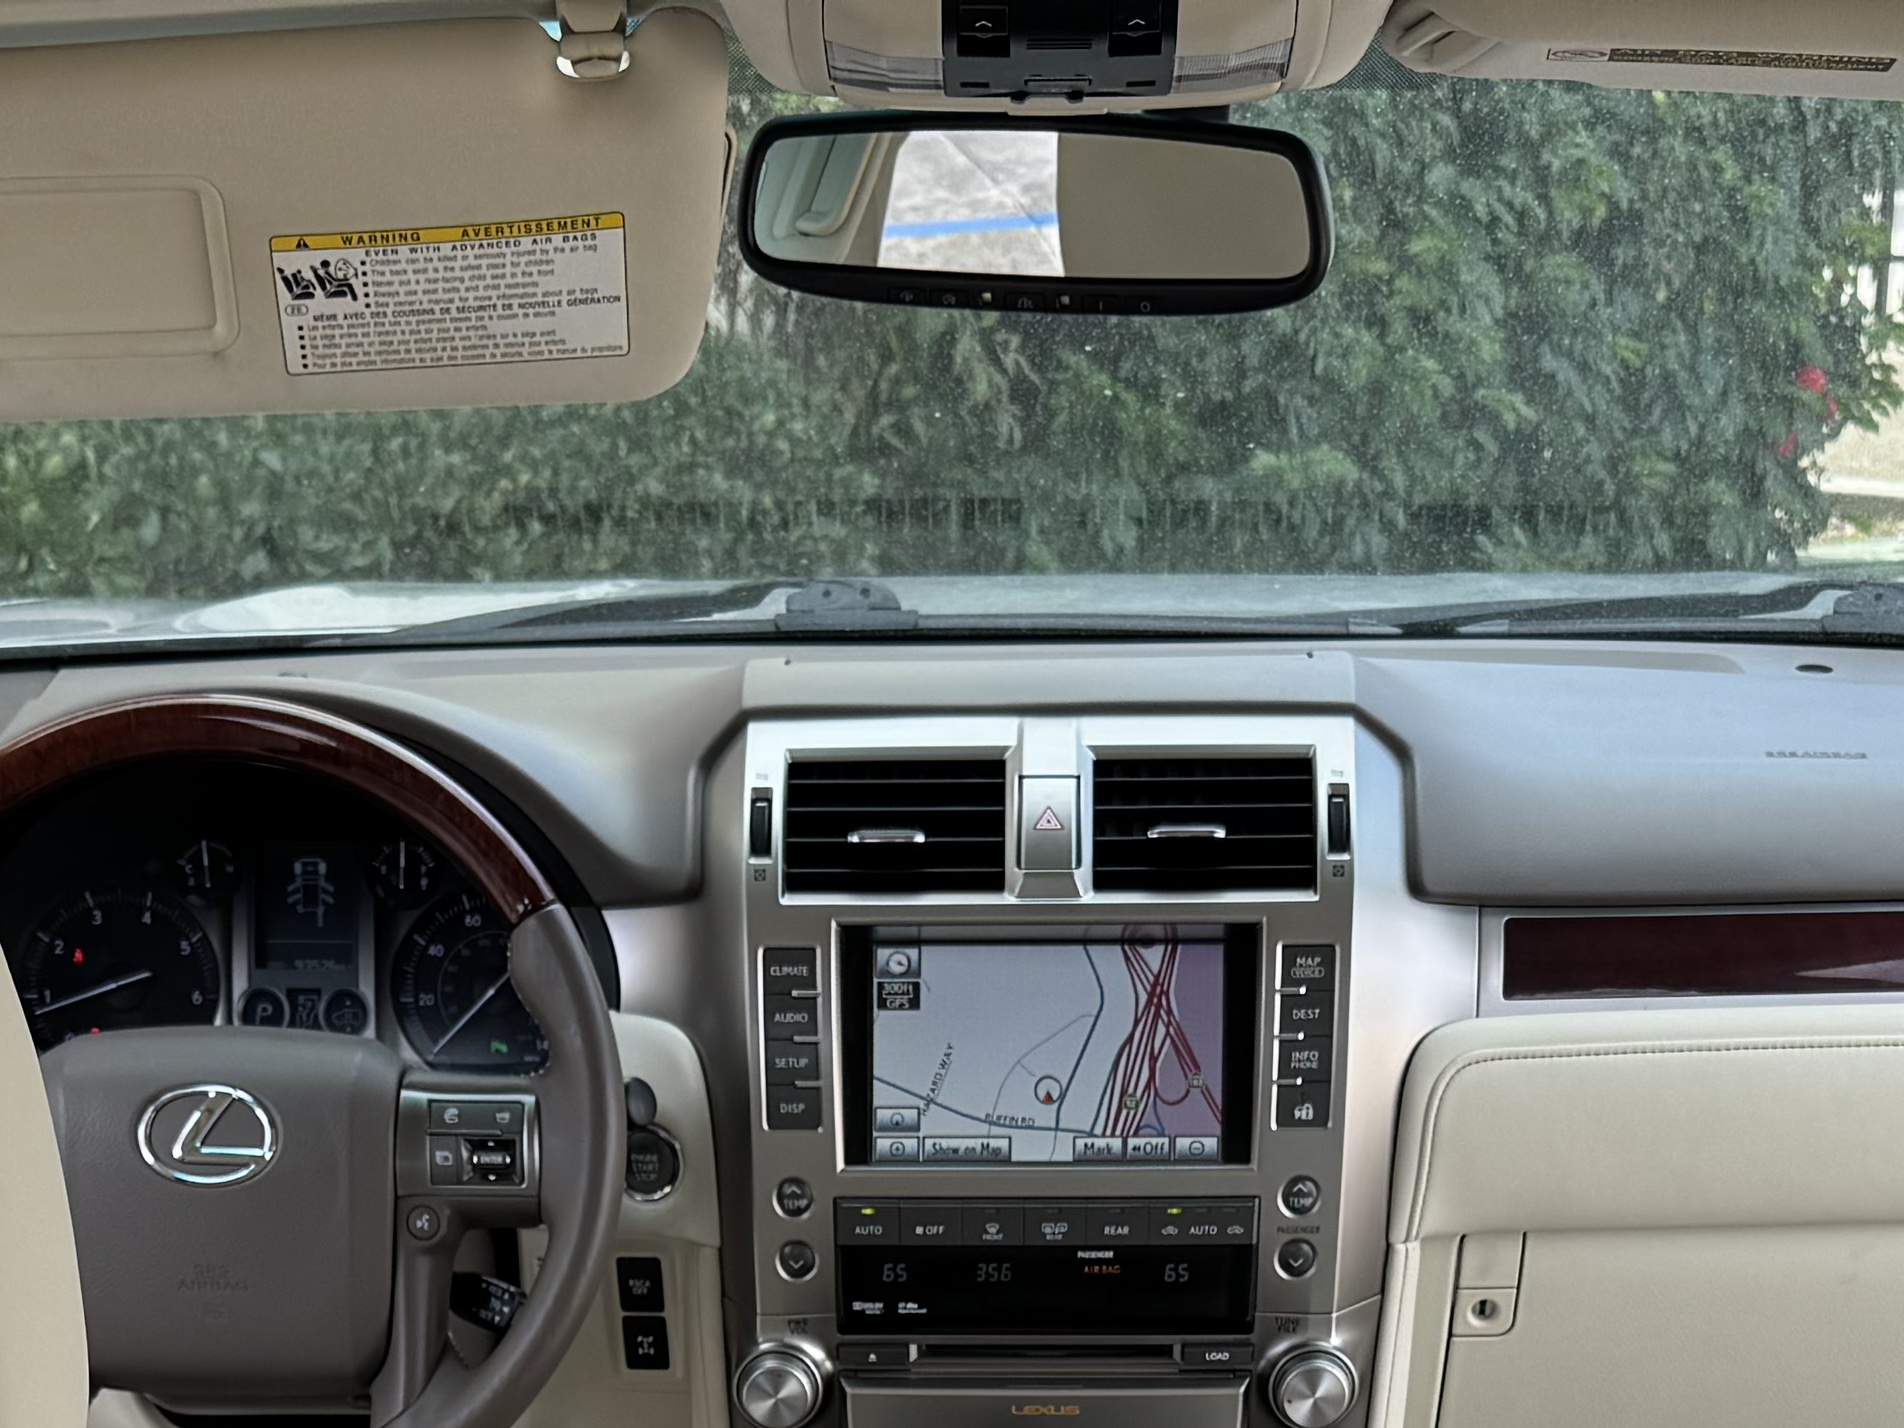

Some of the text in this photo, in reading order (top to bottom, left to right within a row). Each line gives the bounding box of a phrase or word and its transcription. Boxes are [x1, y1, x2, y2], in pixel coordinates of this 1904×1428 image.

[341, 217, 601, 246] WARNING AVERTISSEMENT
[364, 231, 597, 258] EVEN WITH ADVANCED AIR BAGS
[342, 311, 367, 322] AVEC
[369, 310, 387, 320] DES
[391, 307, 435, 318] COUSSINS
[438, 306, 452, 315] DE
[501, 301, 513, 311] DE
[517, 298, 563, 310] NOUVELLE
[92, 910, 102, 925] 3
[141, 911, 152, 924] 4
[465, 915, 481, 927] 60
[54, 940, 64, 954] 2
[180, 940, 191, 955] 5
[427, 944, 444, 957] 40
[1296, 957, 1321, 967] MAP
[770, 966, 809, 977] CLIMATE
[882, 983, 913, 994] 300ft
[192, 991, 203, 1006] 6
[419, 994, 435, 1007] 20
[886, 999, 909, 1010] GPS
[774, 1013, 808, 1023] AUDIO
[1293, 1009, 1320, 1019] DEST
[1292, 1051, 1319, 1061] INFO
[775, 1058, 809, 1068] SETUP
[1291, 1061, 1318, 1069] PHONE
[920, 1042, 954, 1116] HAZARD WAY
[780, 1103, 805, 1114] DISP
[932, 1142, 1002, 1158] Show on Map
[1083, 1142, 1113, 1155] Mark
[1143, 1142, 1165, 1155] Off
[632, 1163, 659, 1172] START
[635, 1173, 658, 1182] STOP
[784, 1198, 809, 1210] TEMP
[1289, 1197, 1314, 1208] TEMP
[854, 1226, 883, 1235] AUTO
[925, 1226, 945, 1235] OFF
[1104, 1226, 1130, 1235] REAR
[1189, 1226, 1217, 1235] AUTO
[1277, 1225, 1320, 1234] PASSENGER
[1077, 1251, 1114, 1259] PASSENGER
[882, 1264, 907, 1282] 65
[977, 1264, 1011, 1282] 356
[1083, 1265, 1121, 1274] AIR BAG
[1164, 1263, 1189, 1282] 65
[632, 1287, 648, 1295] OFF
[1205, 1352, 1229, 1361] LOAD
[1012, 1405, 1080, 1415] LEXUS
